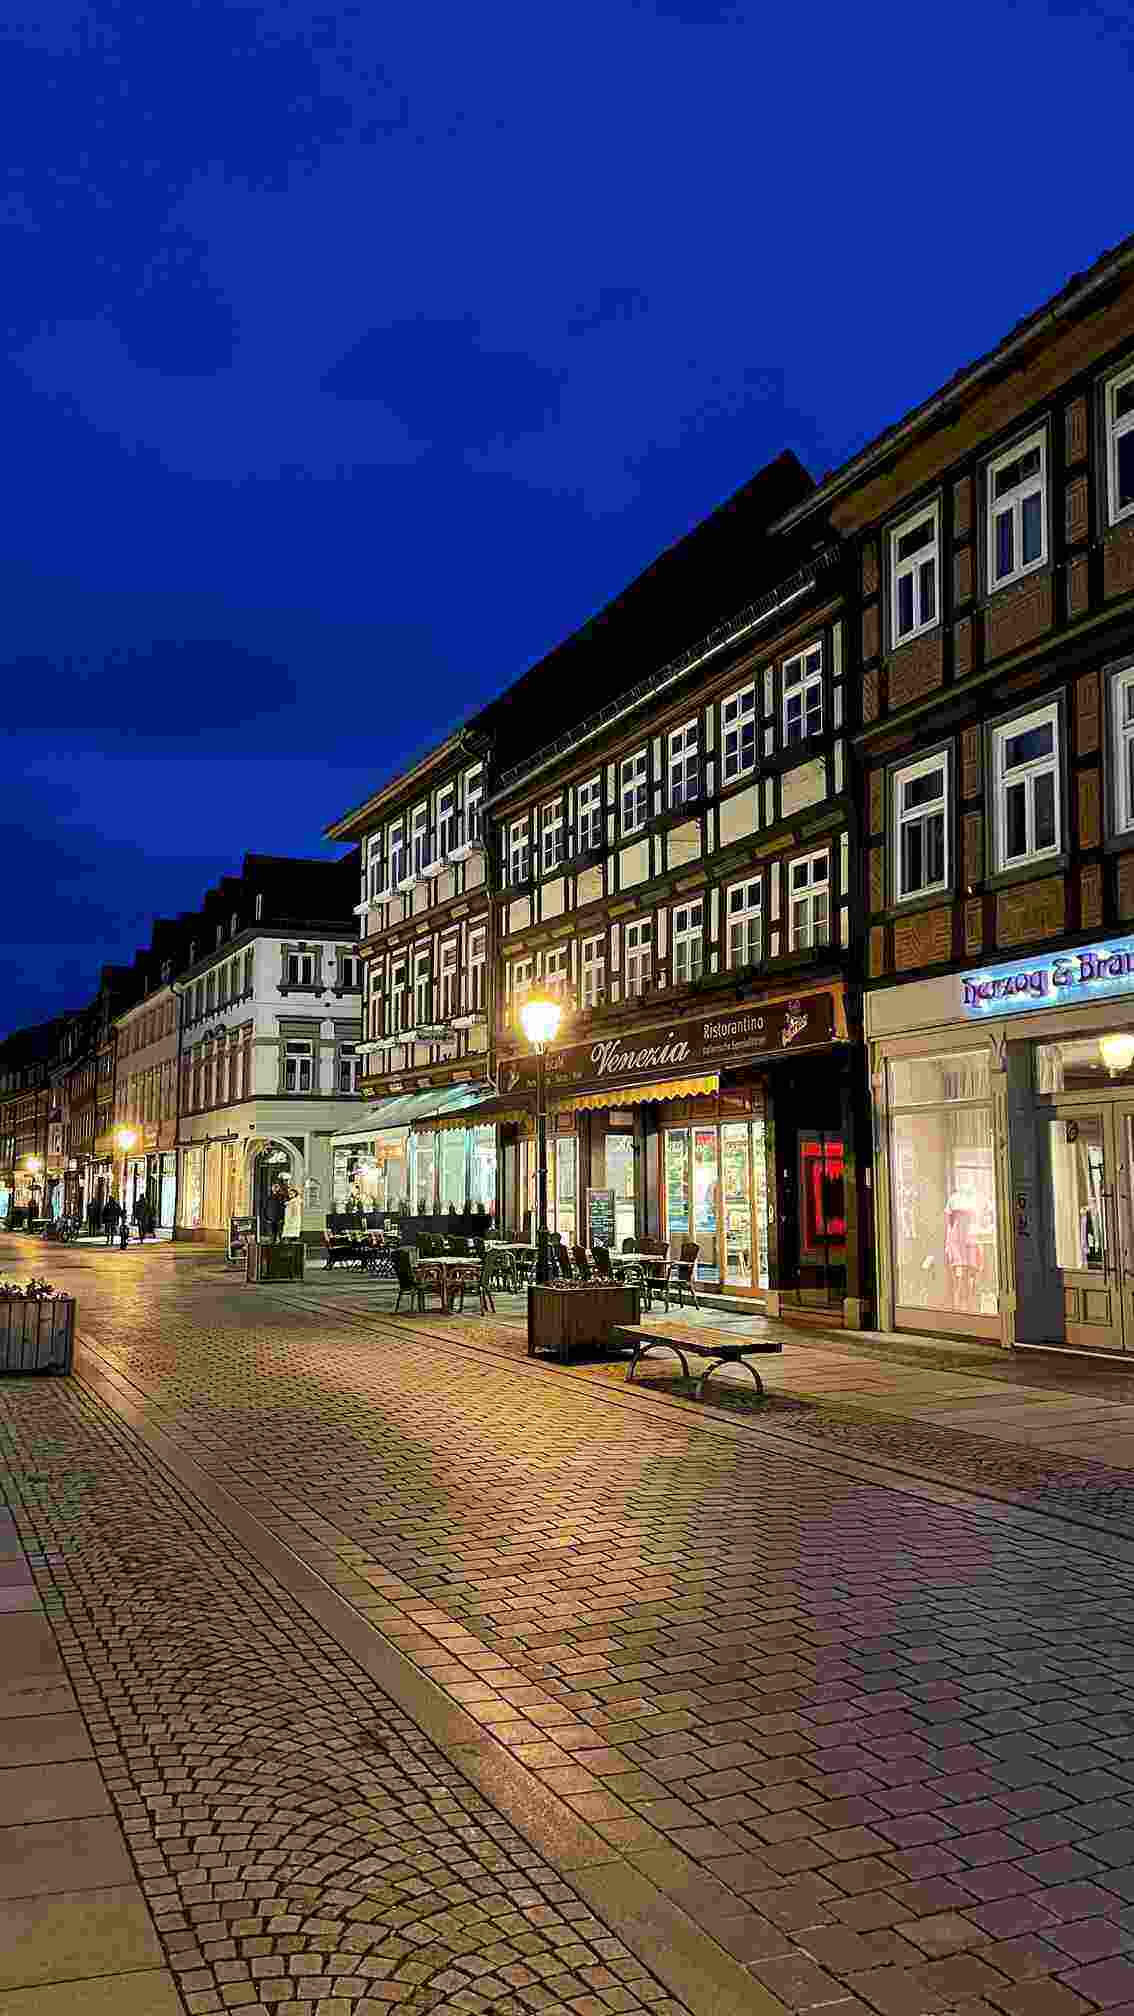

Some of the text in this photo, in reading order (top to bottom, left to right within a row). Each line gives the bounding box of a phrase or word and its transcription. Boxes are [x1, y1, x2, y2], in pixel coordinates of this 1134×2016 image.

[1053, 958, 1072, 986] &
[703, 1016, 764, 1040] Ristorantino
[591, 1031, 691, 1076] Venezia
